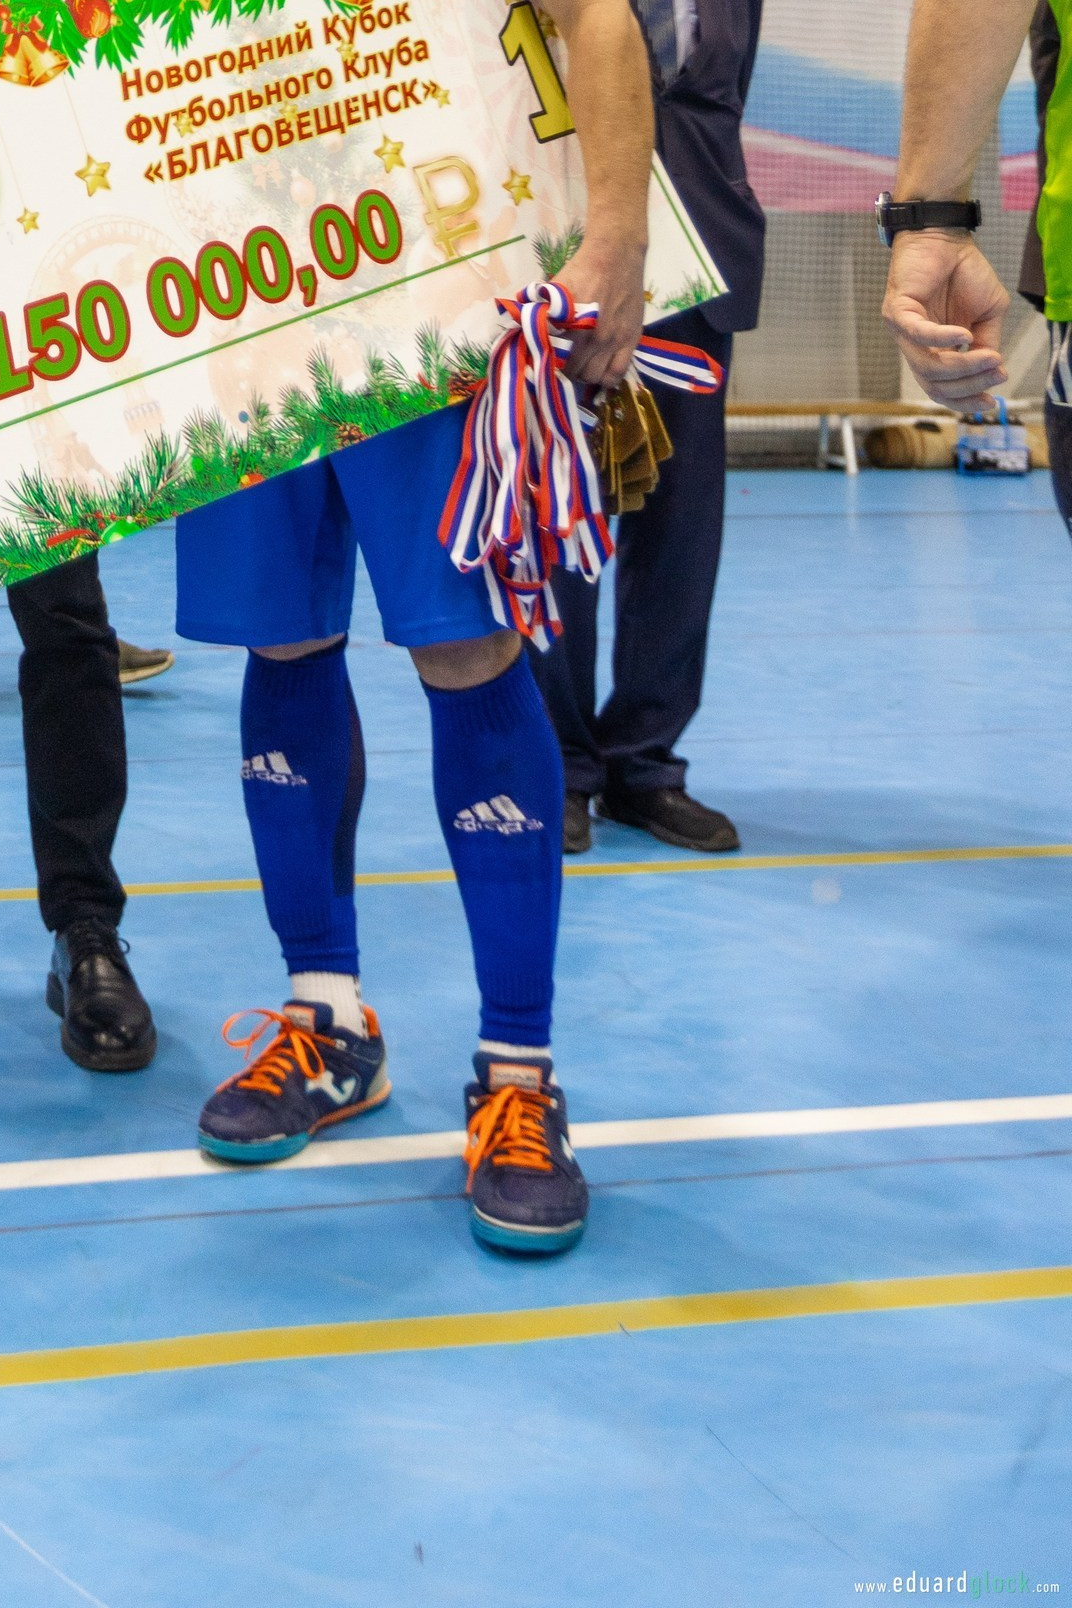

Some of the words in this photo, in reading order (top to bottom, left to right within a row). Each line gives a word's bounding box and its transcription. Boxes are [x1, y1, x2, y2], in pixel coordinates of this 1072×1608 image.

[120, 22, 314, 101] Новогодний
[322, 0, 412, 45] Кубок
[125, 65, 334, 145] Футбольного
[343, 38, 430, 84] Клуба
[143, 78, 440, 184] «БЛАГОВЕЩЕНСК»
[146, 189, 403, 338] 000,00
